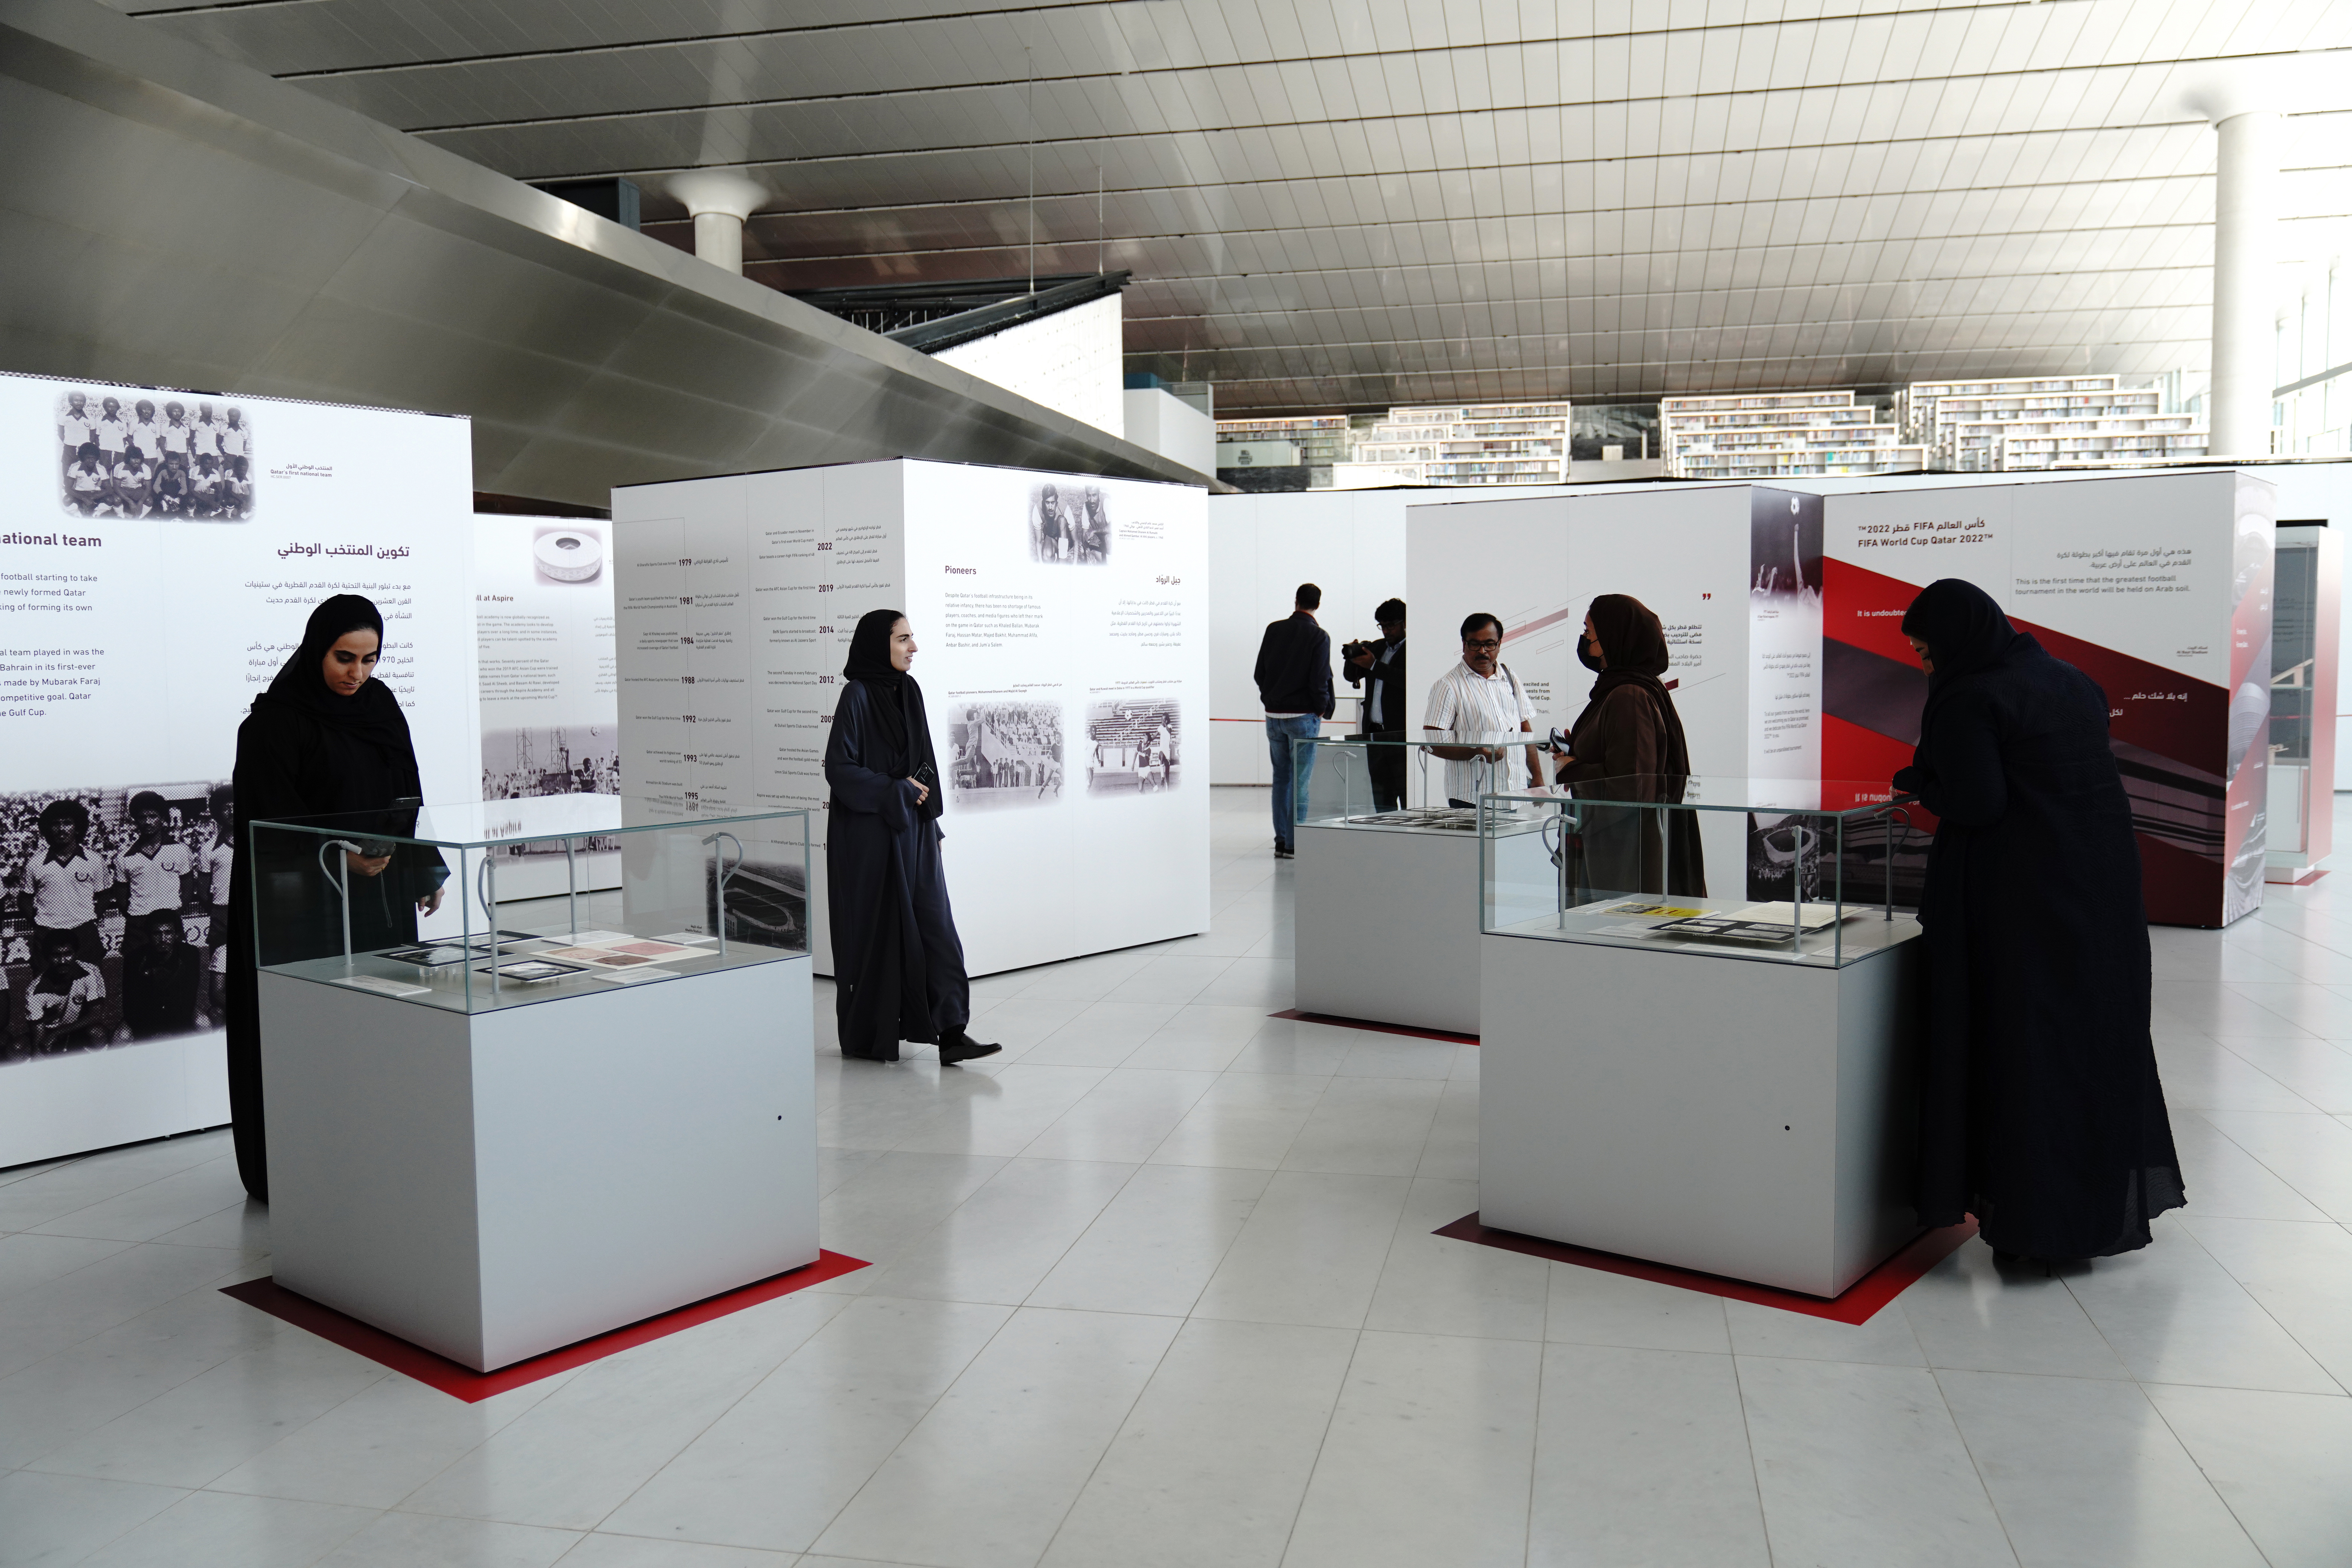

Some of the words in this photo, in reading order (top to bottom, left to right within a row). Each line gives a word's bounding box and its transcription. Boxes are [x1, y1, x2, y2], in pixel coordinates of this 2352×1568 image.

[1914, 522, 1934, 530] FIFA
[1937, 521, 1962, 531] العالم
[1965, 517, 1985, 530] كأس
[1892, 524, 1909, 534] قطر
[62, 534, 101, 547] team
[1880, 538, 1908, 546] World
[1911, 537, 1928, 546] Cup
[278, 542, 321, 559] الوطني
[326, 545, 372, 557] المنتخب
[377, 546, 409, 559] تكوين
[945, 565, 976, 574] Pioneers
[36, 574, 67, 582] starting
[272, 582, 282, 590] في
[4, 588, 28, 597] newly
[28, 604, 60, 612] forming
[34, 649, 60, 657] played
[47, 693, 66, 701] goal.
